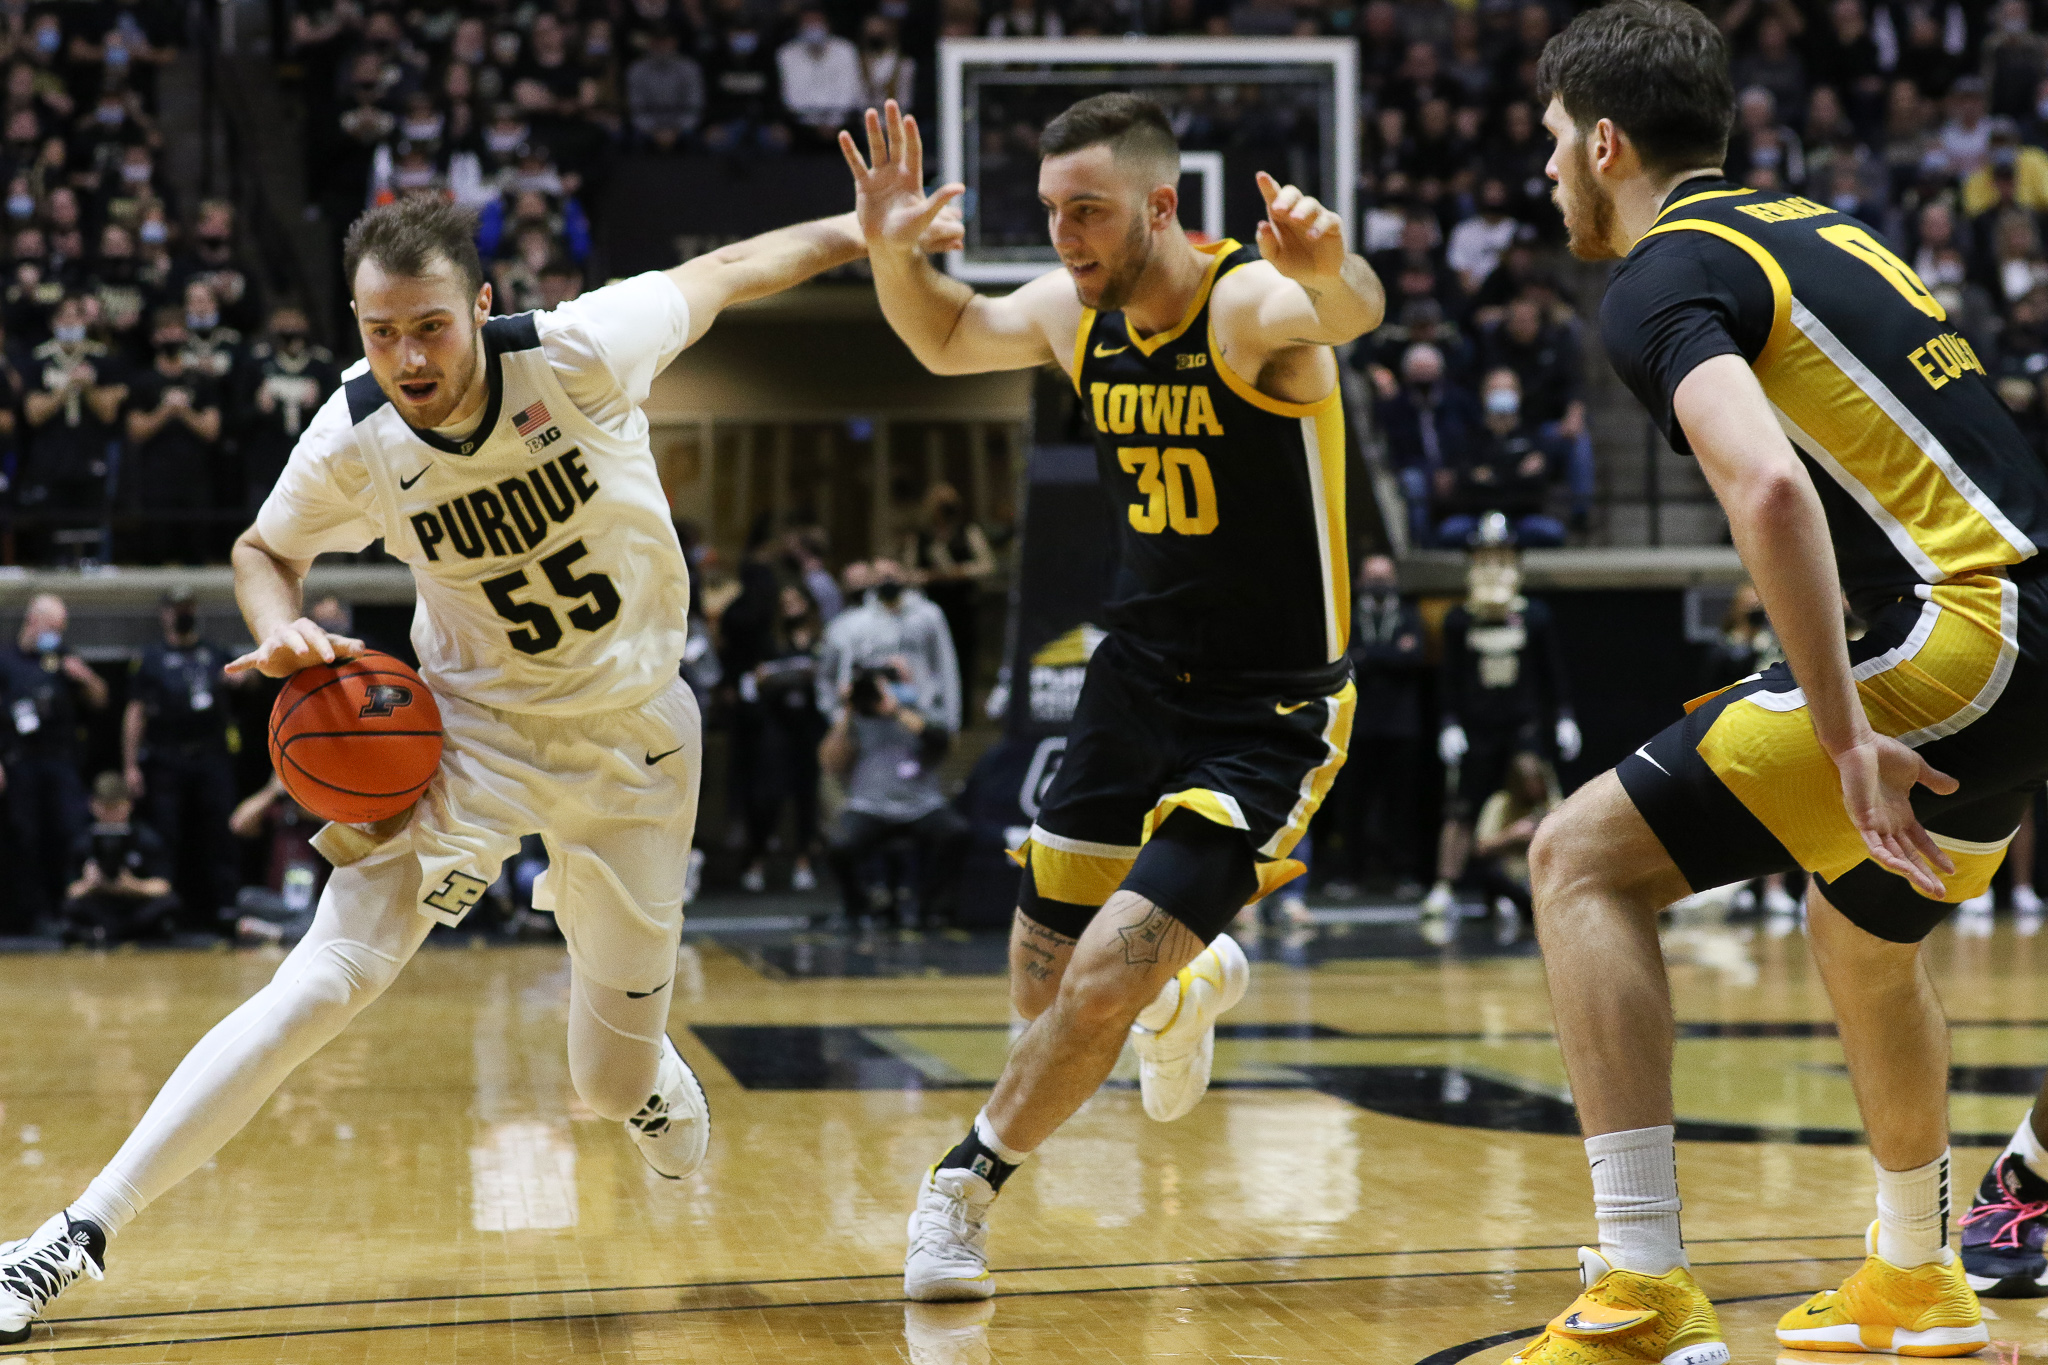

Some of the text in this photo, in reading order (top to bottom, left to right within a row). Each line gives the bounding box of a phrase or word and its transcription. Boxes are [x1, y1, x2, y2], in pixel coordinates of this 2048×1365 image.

[1816, 224, 1946, 322] 0
[1090, 382, 1225, 436] IOWA
[410, 447, 599, 562] PURDUE
[1117, 446, 1220, 535] 30
[480, 538, 622, 655] 55
[359, 685, 414, 718] P
[423, 869, 489, 916] P
